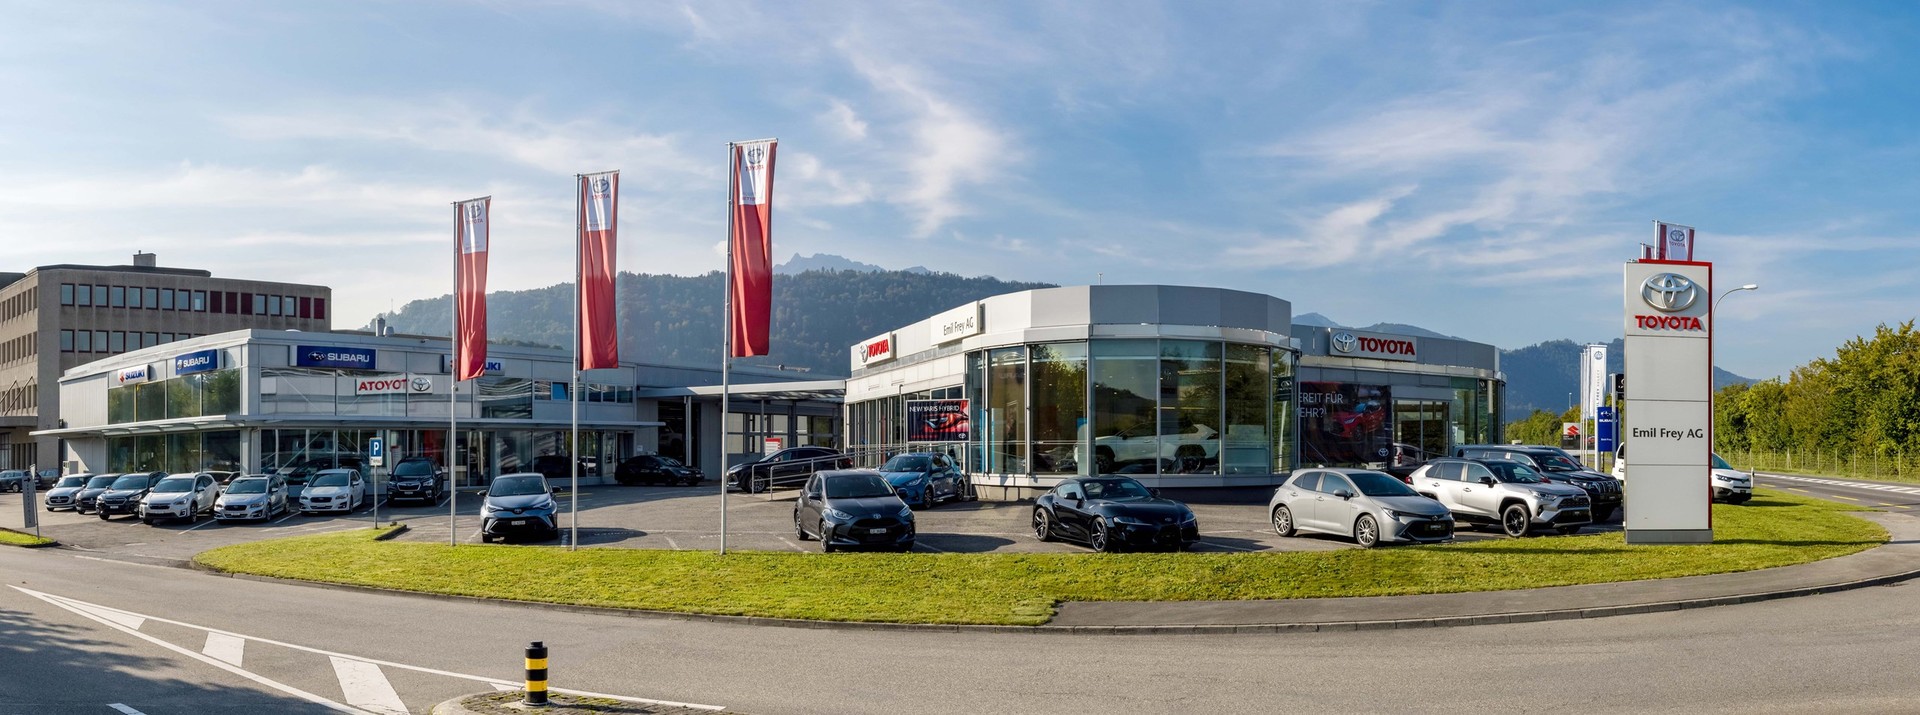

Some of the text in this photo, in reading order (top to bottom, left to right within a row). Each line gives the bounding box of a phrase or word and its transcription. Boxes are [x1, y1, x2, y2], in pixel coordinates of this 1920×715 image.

[943, 316, 974, 336] Emil Frey AG
[1635, 315, 1702, 330] TOYOTA
[867, 339, 889, 357] TOYOTA
[1358, 337, 1415, 355] TOYOTA
[183, 356, 210, 368] SUBARU
[327, 352, 370, 363] SUBARU
[485, 361, 501, 371] UKI
[125, 369, 145, 380] SUZUKI
[1299, 391, 1344, 404] EREIT FÜR
[1299, 407, 1325, 418] EHR?
[1633, 427, 1704, 441] Emil Frey AG
[373, 441, 380, 456] P
